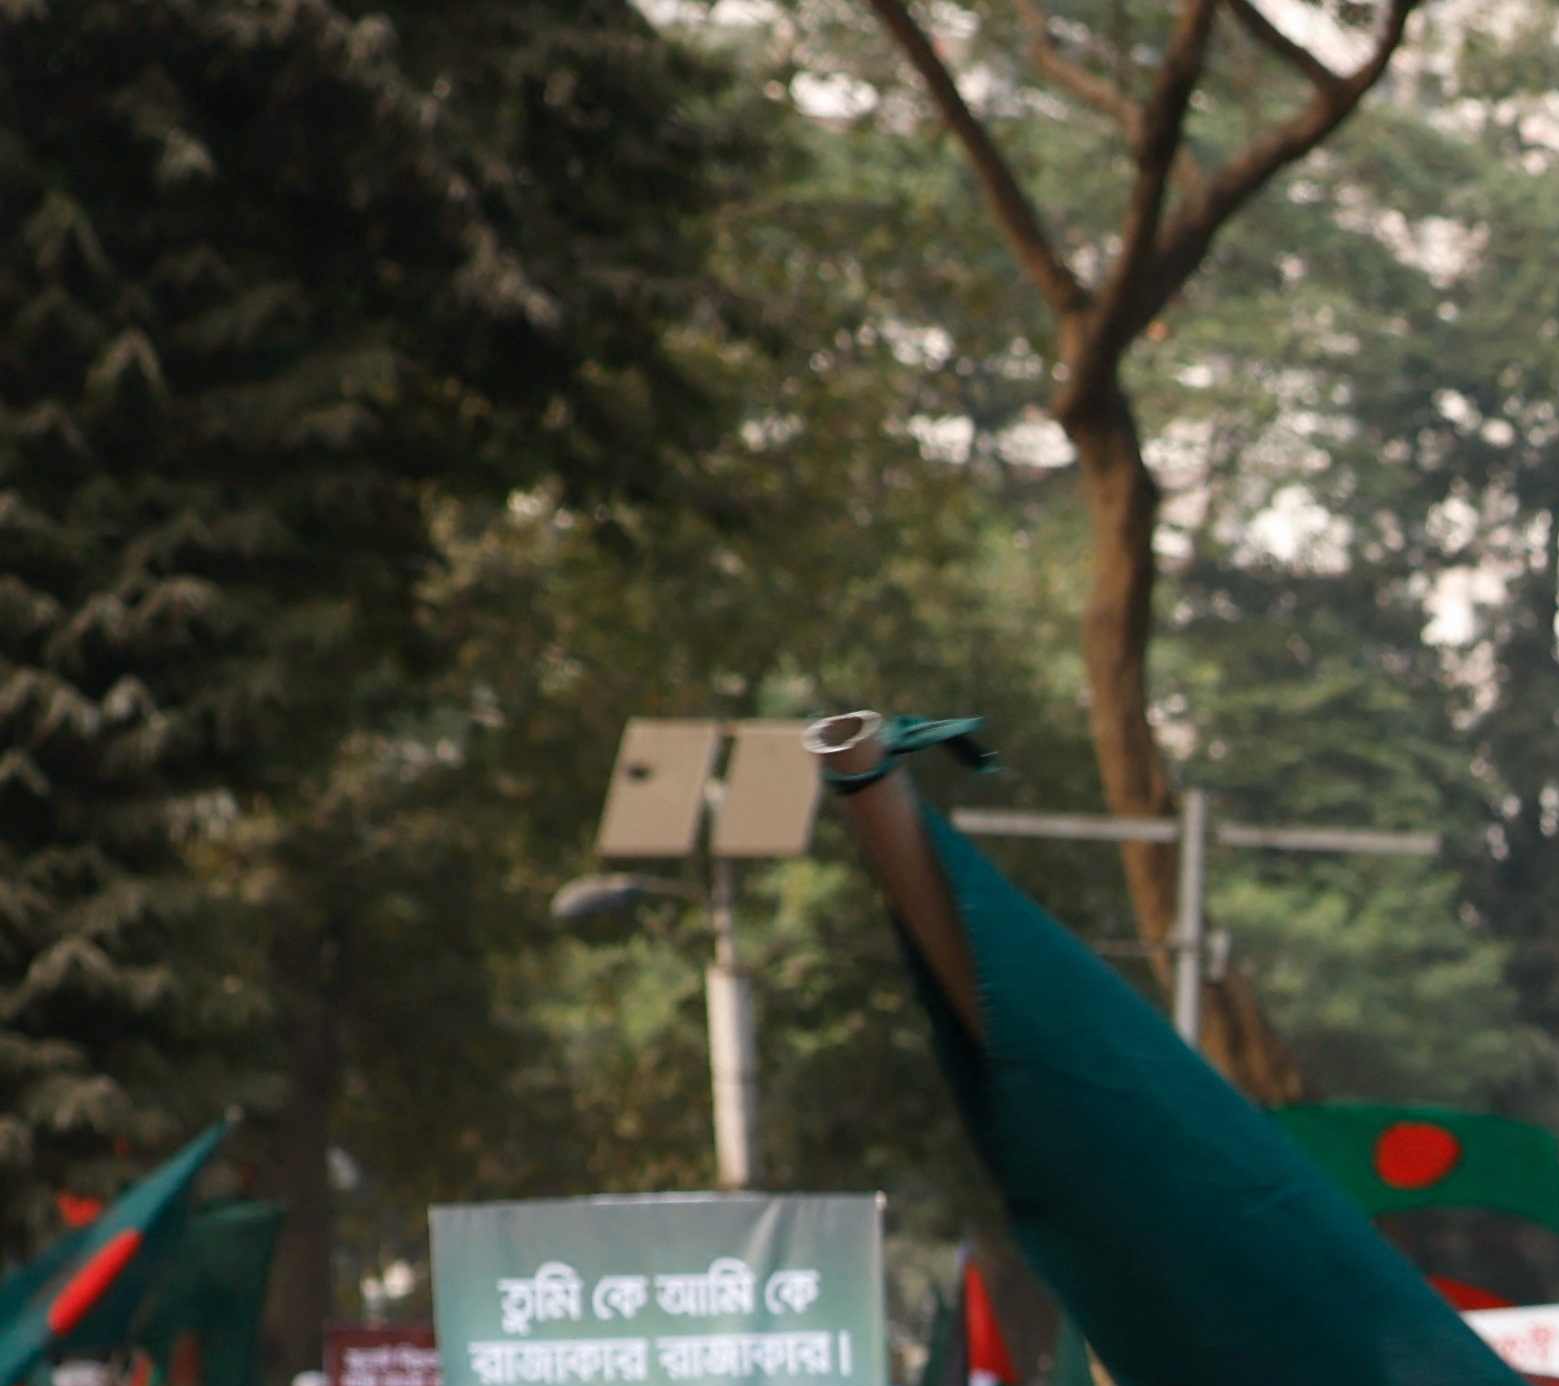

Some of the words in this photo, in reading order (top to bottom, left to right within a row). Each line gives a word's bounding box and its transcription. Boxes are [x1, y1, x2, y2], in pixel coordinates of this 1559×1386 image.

[499, 1261, 582, 1335] তুমি
[593, 1274, 648, 1321] কে
[655, 1256, 755, 1317] আমি
[766, 1268, 820, 1315] কে
[469, 1338, 648, 1385] রাজাকার
